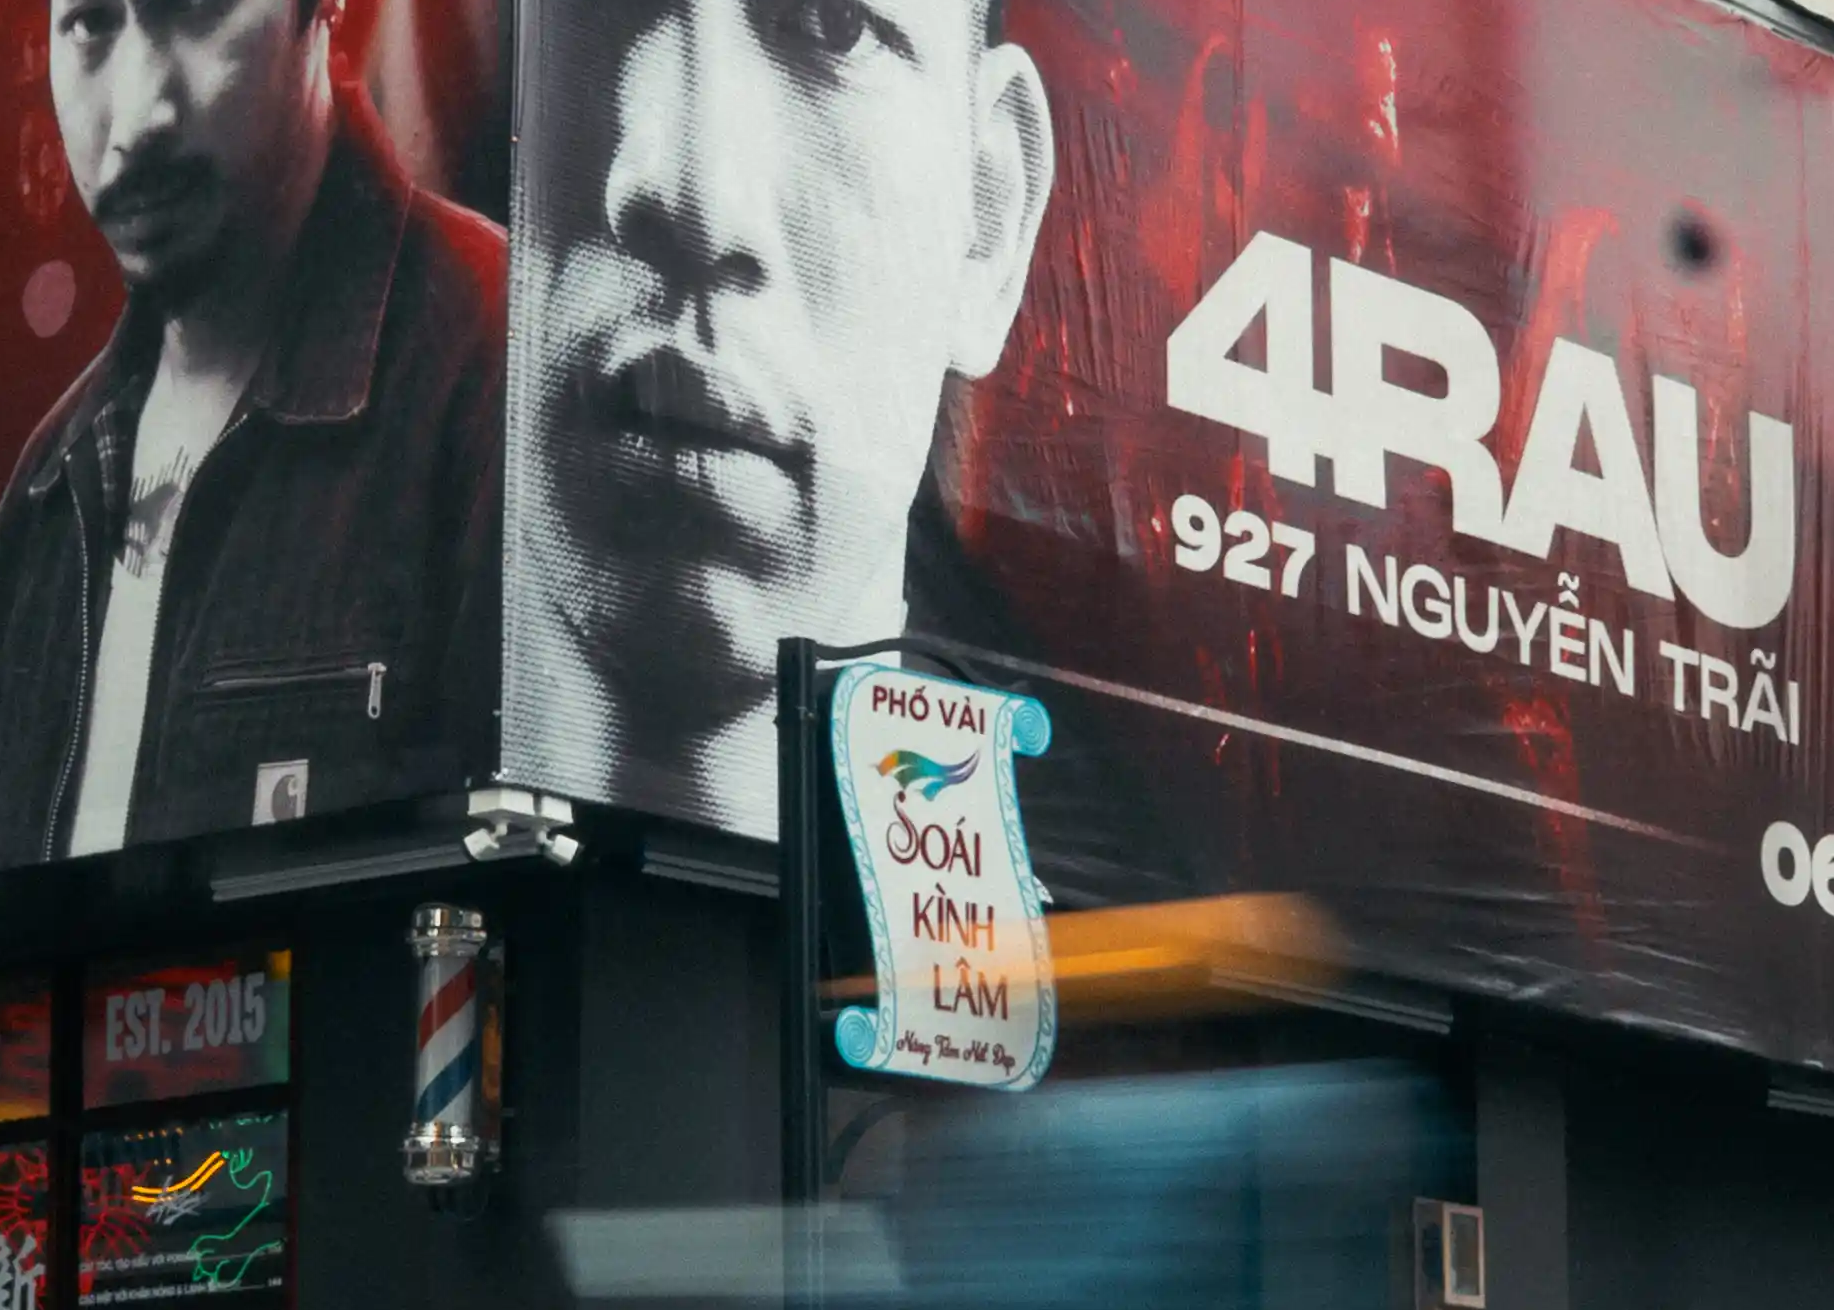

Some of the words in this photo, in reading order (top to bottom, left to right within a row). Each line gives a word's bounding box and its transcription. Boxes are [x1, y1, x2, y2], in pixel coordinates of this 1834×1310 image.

[1166, 229, 1796, 630] 4RAU
[1170, 493, 1316, 599] 927
[1346, 571, 1635, 697] NGUYỄN
[1659, 649, 1800, 747] TRÃI
[873, 685, 929, 721] PHỐ
[887, 791, 981, 878] SOÁI
[913, 883, 994, 951] KÌNH
[105, 989, 172, 1062] EST.
[183, 971, 266, 1053] 2015
[934, 958, 1007, 1021] LÂM
